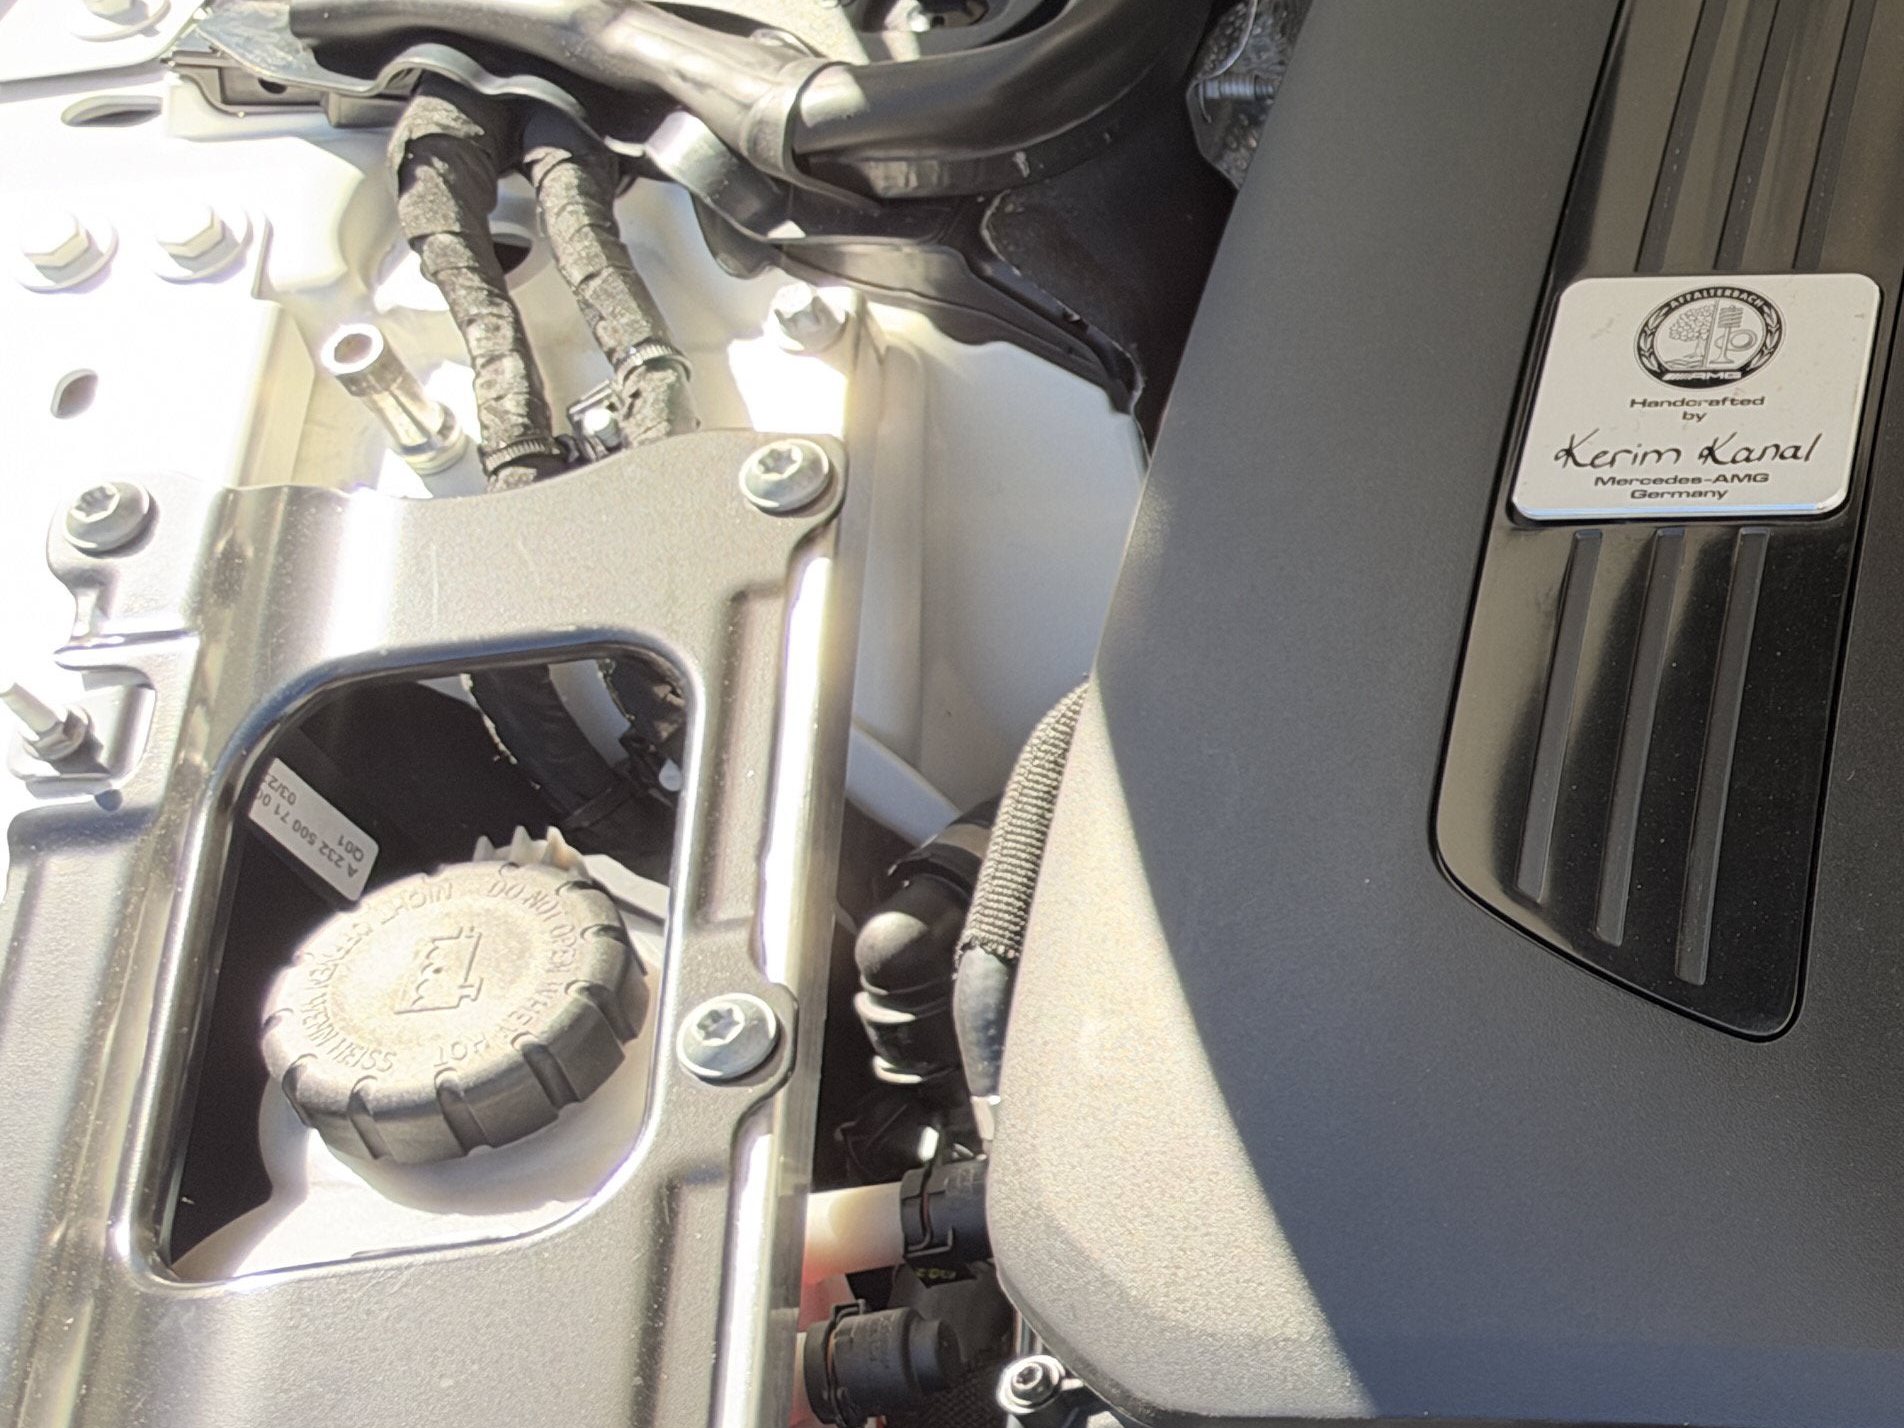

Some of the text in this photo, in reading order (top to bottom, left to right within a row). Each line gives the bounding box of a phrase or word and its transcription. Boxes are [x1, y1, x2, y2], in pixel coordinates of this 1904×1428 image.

[1629, 395, 1766, 409] Handcrafted
[1681, 410, 1707, 423] by
[1553, 428, 1824, 470] Kerim Kanal
[1594, 472, 1770, 487] Mercedes-AMG
[1630, 488, 1728, 501] Germany
[273, 803, 291, 824] 71
[291, 819, 318, 847] 500
[318, 839, 346, 869] 232
[336, 834, 365, 864] Q01
[346, 862, 360, 879] A
[487, 880, 526, 898] DO
